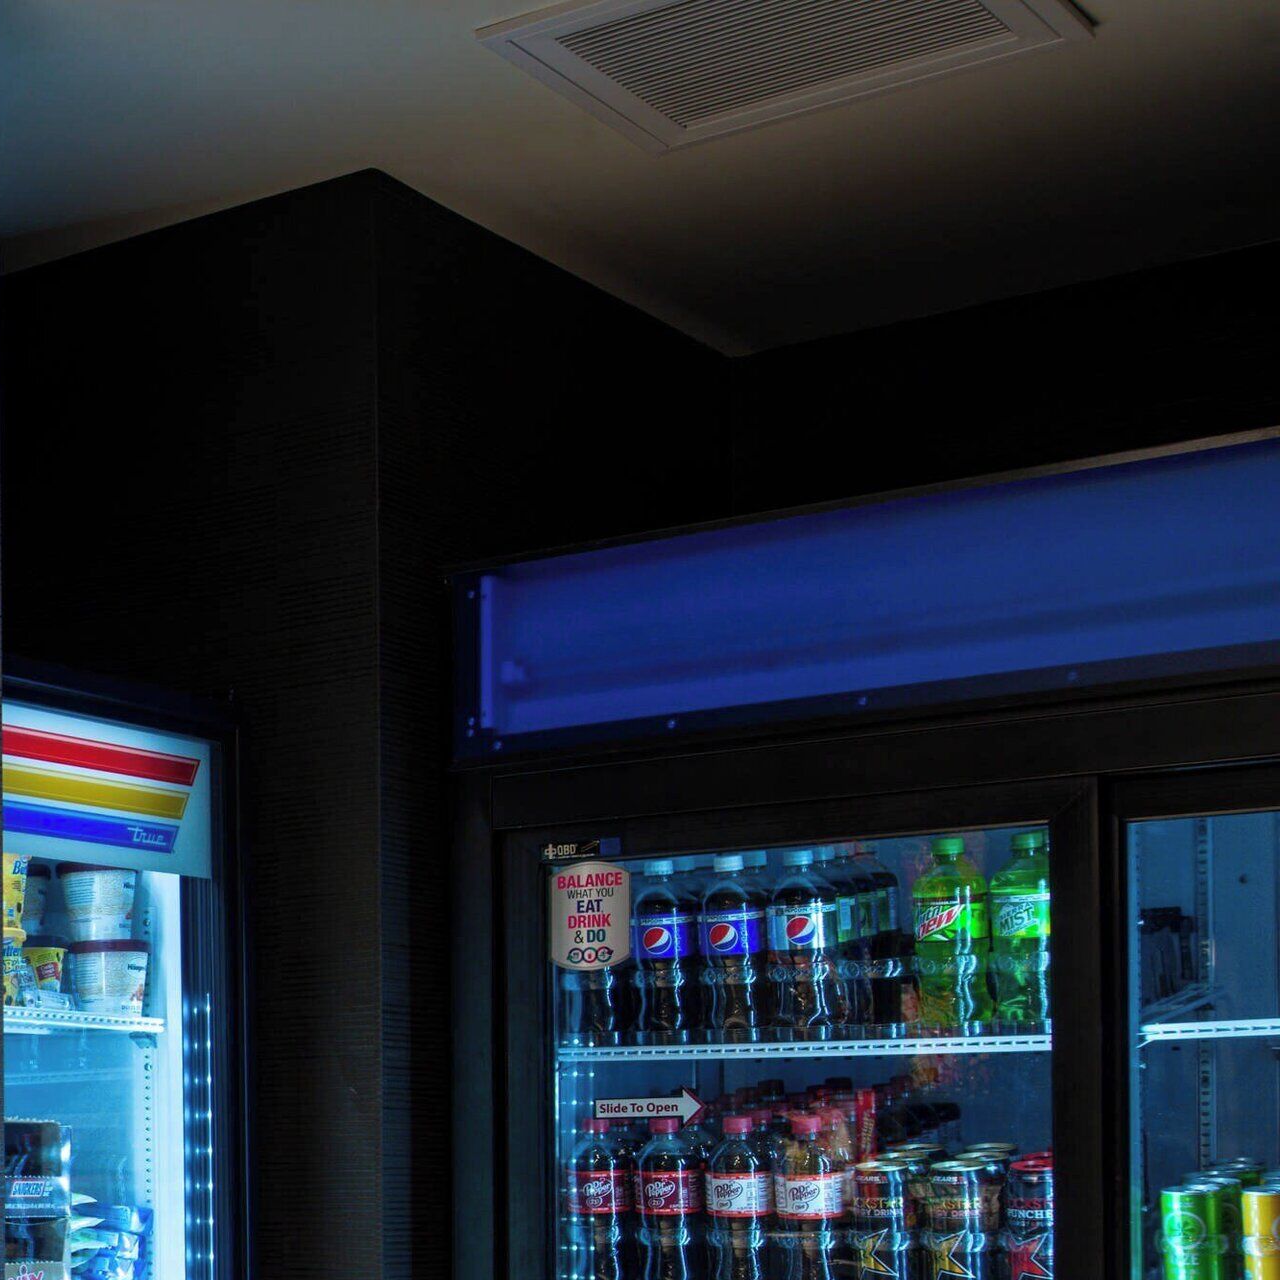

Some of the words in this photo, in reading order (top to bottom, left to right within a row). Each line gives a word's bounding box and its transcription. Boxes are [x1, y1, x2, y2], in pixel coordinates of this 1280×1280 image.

[557, 871, 623, 890] BALANCE
[567, 888, 593, 899] WHAT
[596, 887, 614, 898] YOU
[568, 913, 612, 929] DRINK
[998, 908, 1035, 932] MIST
[574, 930, 584, 943] &
[586, 929, 606, 943] DO
[599, 1102, 629, 1114] Slide
[630, 1103, 644, 1113] To
[646, 1102, 679, 1115] Open
[12, 1182, 43, 1196] SNICKERS
[584, 1181, 612, 1199] Pepper
[646, 1182, 675, 1198] Pepper
[715, 1185, 742, 1200] Pepper
[790, 1186, 820, 1201] Pepper
